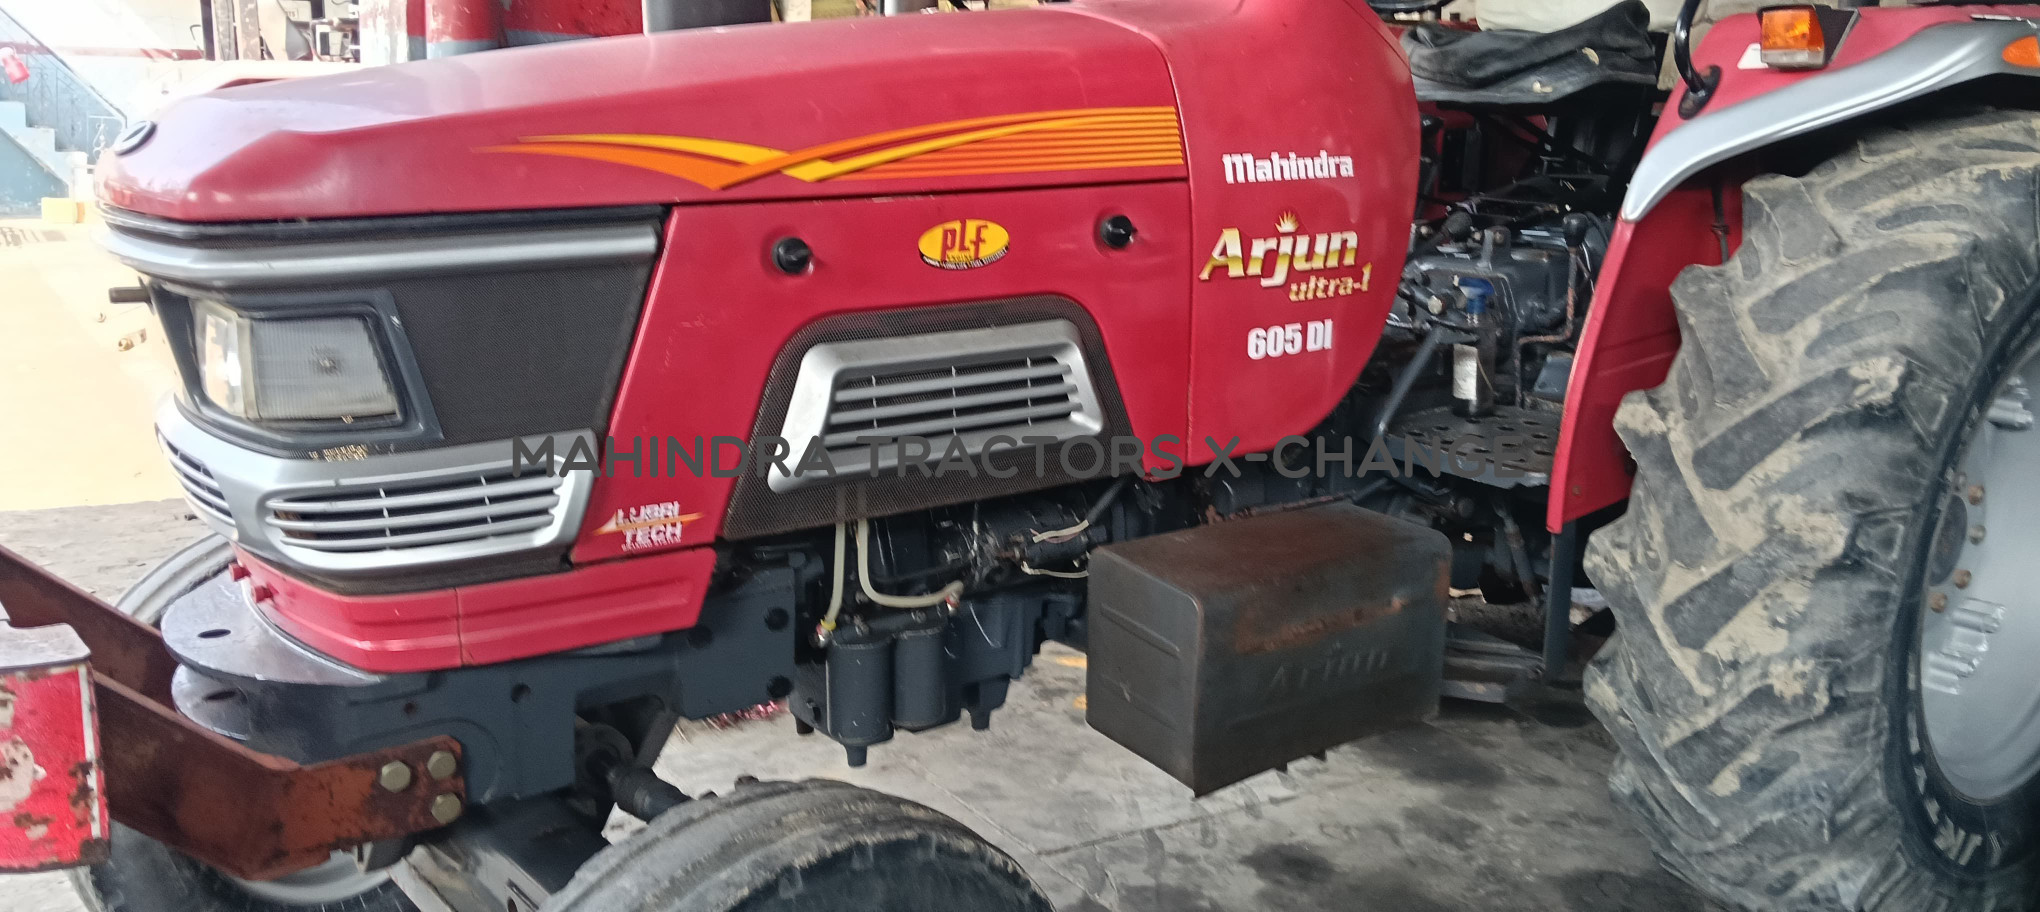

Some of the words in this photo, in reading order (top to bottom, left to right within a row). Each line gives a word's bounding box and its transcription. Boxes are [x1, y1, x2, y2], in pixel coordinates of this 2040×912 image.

[1222, 150, 1354, 184] Mahindra
[1198, 212, 1358, 287] Arjun
[1289, 262, 1373, 302] ultra-1
[1247, 322, 1302, 360] 605
[1306, 318, 1333, 352] DI
[616, 501, 680, 526] LUBRI
[622, 521, 682, 546] TECH
